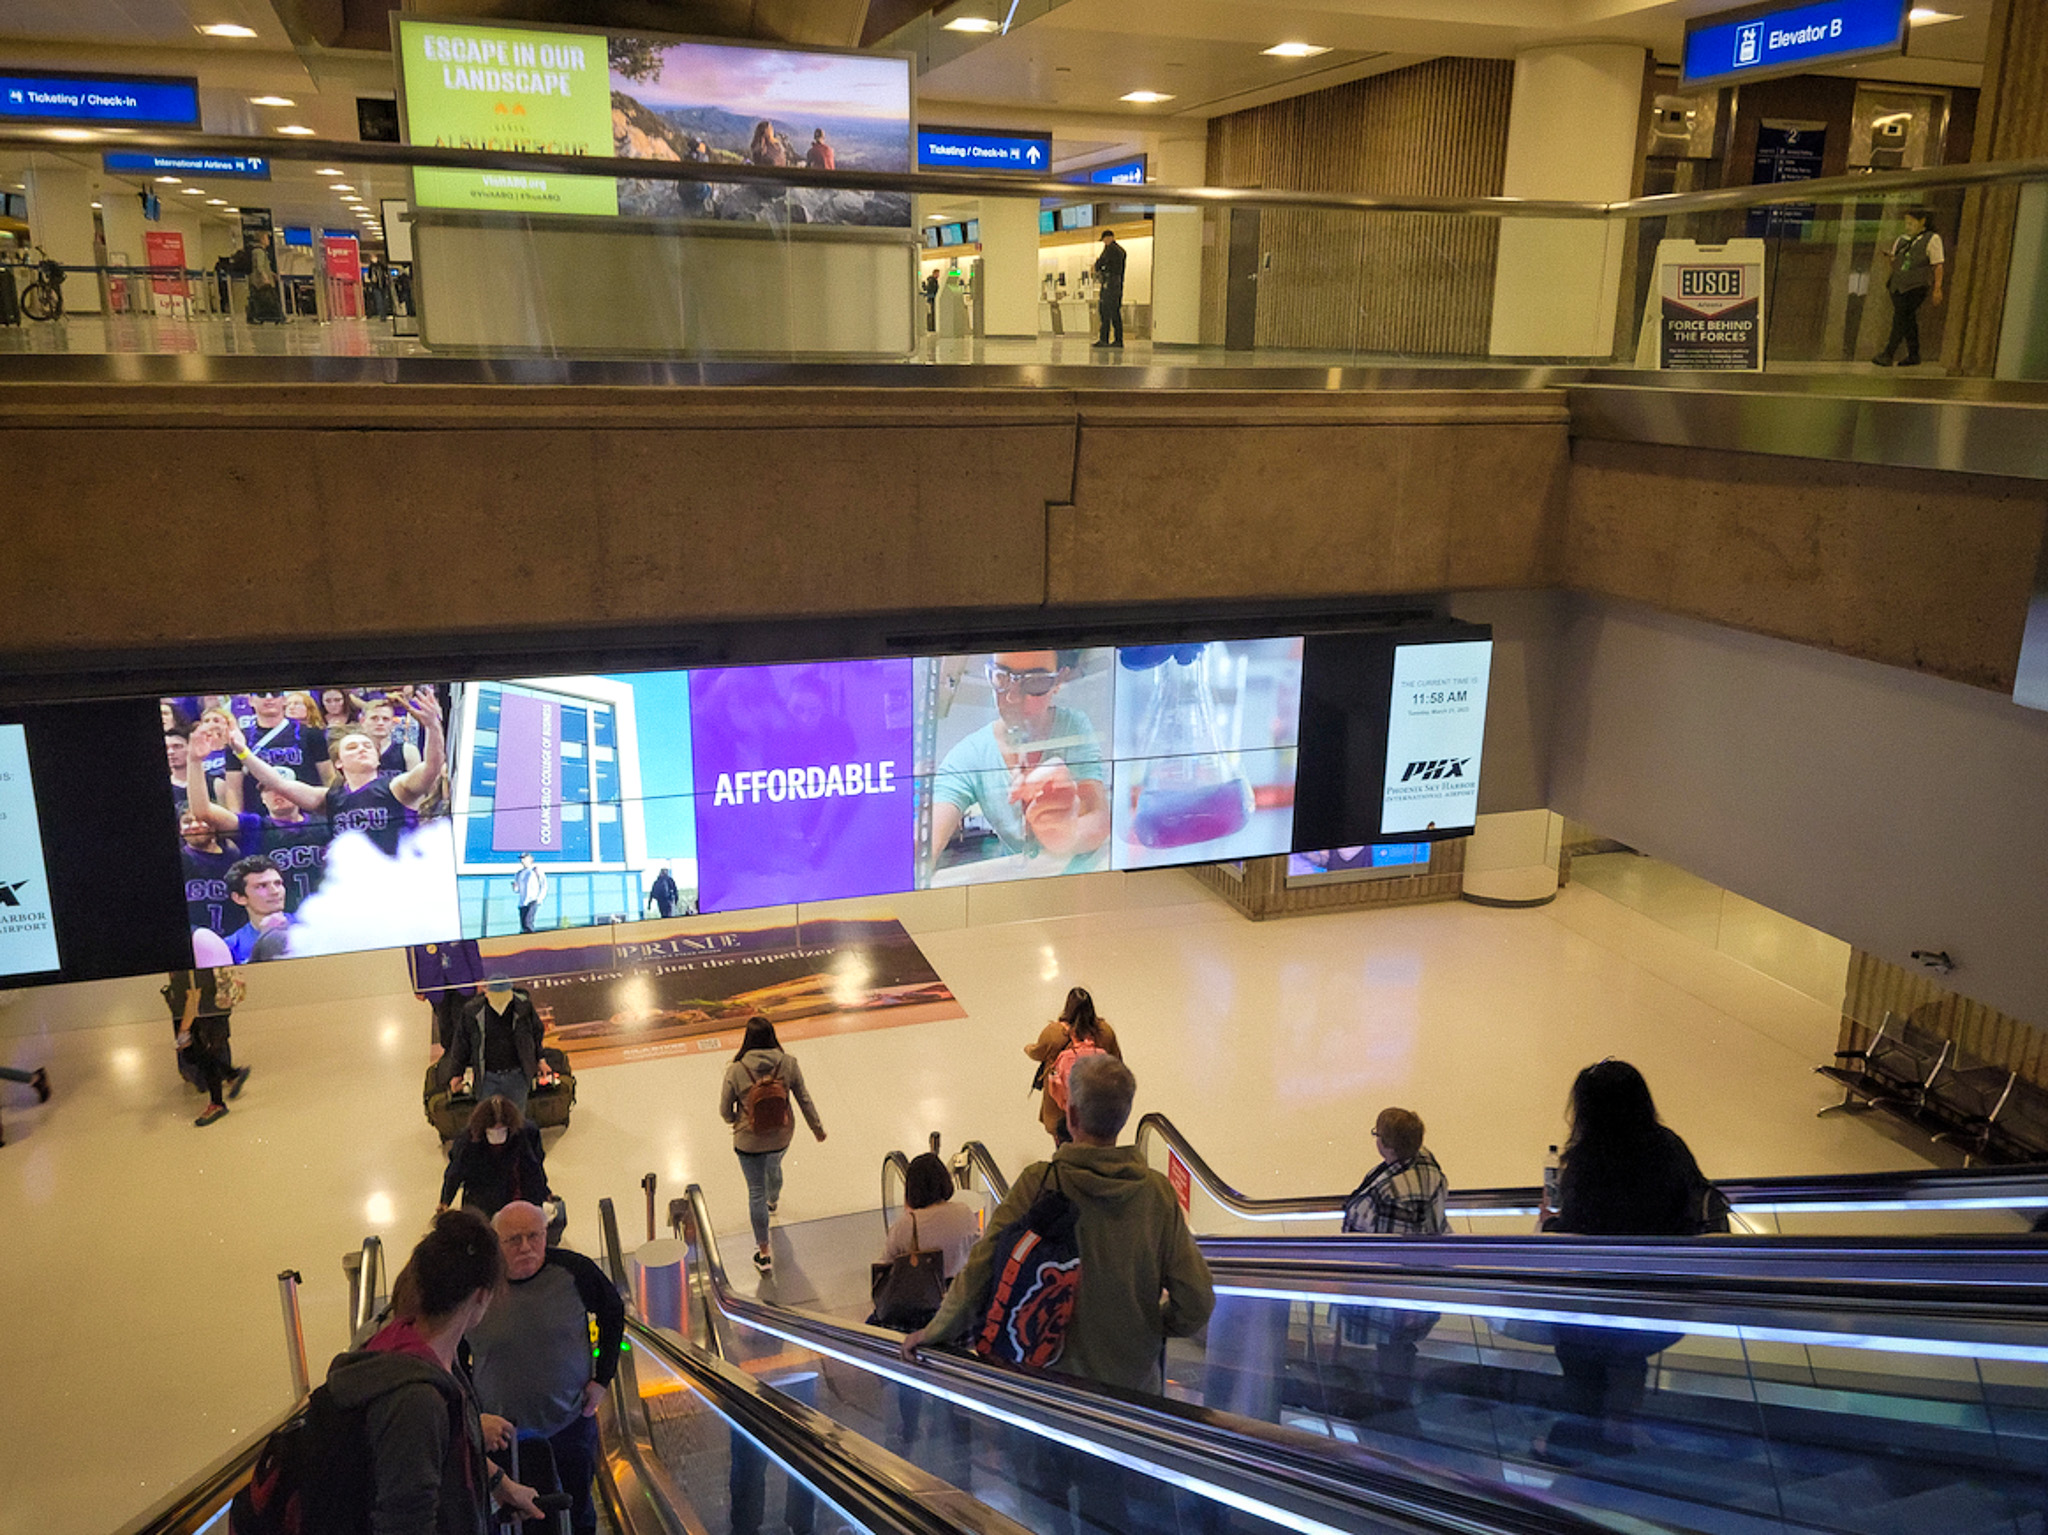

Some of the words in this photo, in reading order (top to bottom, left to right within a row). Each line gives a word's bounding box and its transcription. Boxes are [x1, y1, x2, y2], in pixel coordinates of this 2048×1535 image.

[1768, 25, 1828, 50] Elevator
[1830, 18, 1843, 38] B
[424, 34, 510, 66] ESCAPE
[512, 42, 536, 68] IN
[539, 44, 586, 71] OUR
[443, 64, 572, 97] LANDSCAPE
[27, 91, 79, 107] Ticketing
[81, 93, 86, 105] /
[87, 94, 137, 107] Check-In
[1787, 127, 1799, 144] 2
[928, 144, 967, 157] Ticketing
[972, 146, 1009, 158] Check-In
[154, 157, 203, 169] International
[204, 160, 234, 171] Airlines
[327, 246, 349, 257] Lynx
[1693, 271, 1730, 294] USO
[1668, 320, 1705, 331] FORCE
[1707, 320, 1753, 331] BEHIND
[1674, 331, 1698, 342] THE
[1700, 332, 1747, 343] FORCES
[1413, 692, 1445, 704] 11:58
[1446, 690, 1468, 702] AM
[1400, 757, 1472, 782] PHX
[713, 760, 897, 807] AFFORDABLE
[1386, 786, 1423, 796] PHOENIX
[1441, 782, 1476, 791] HARBOR
[0, 912, 47, 923] ARBOR
[616, 933, 742, 958] PRIME
[655, 962, 697, 976] just
[702, 959, 736, 969] the
